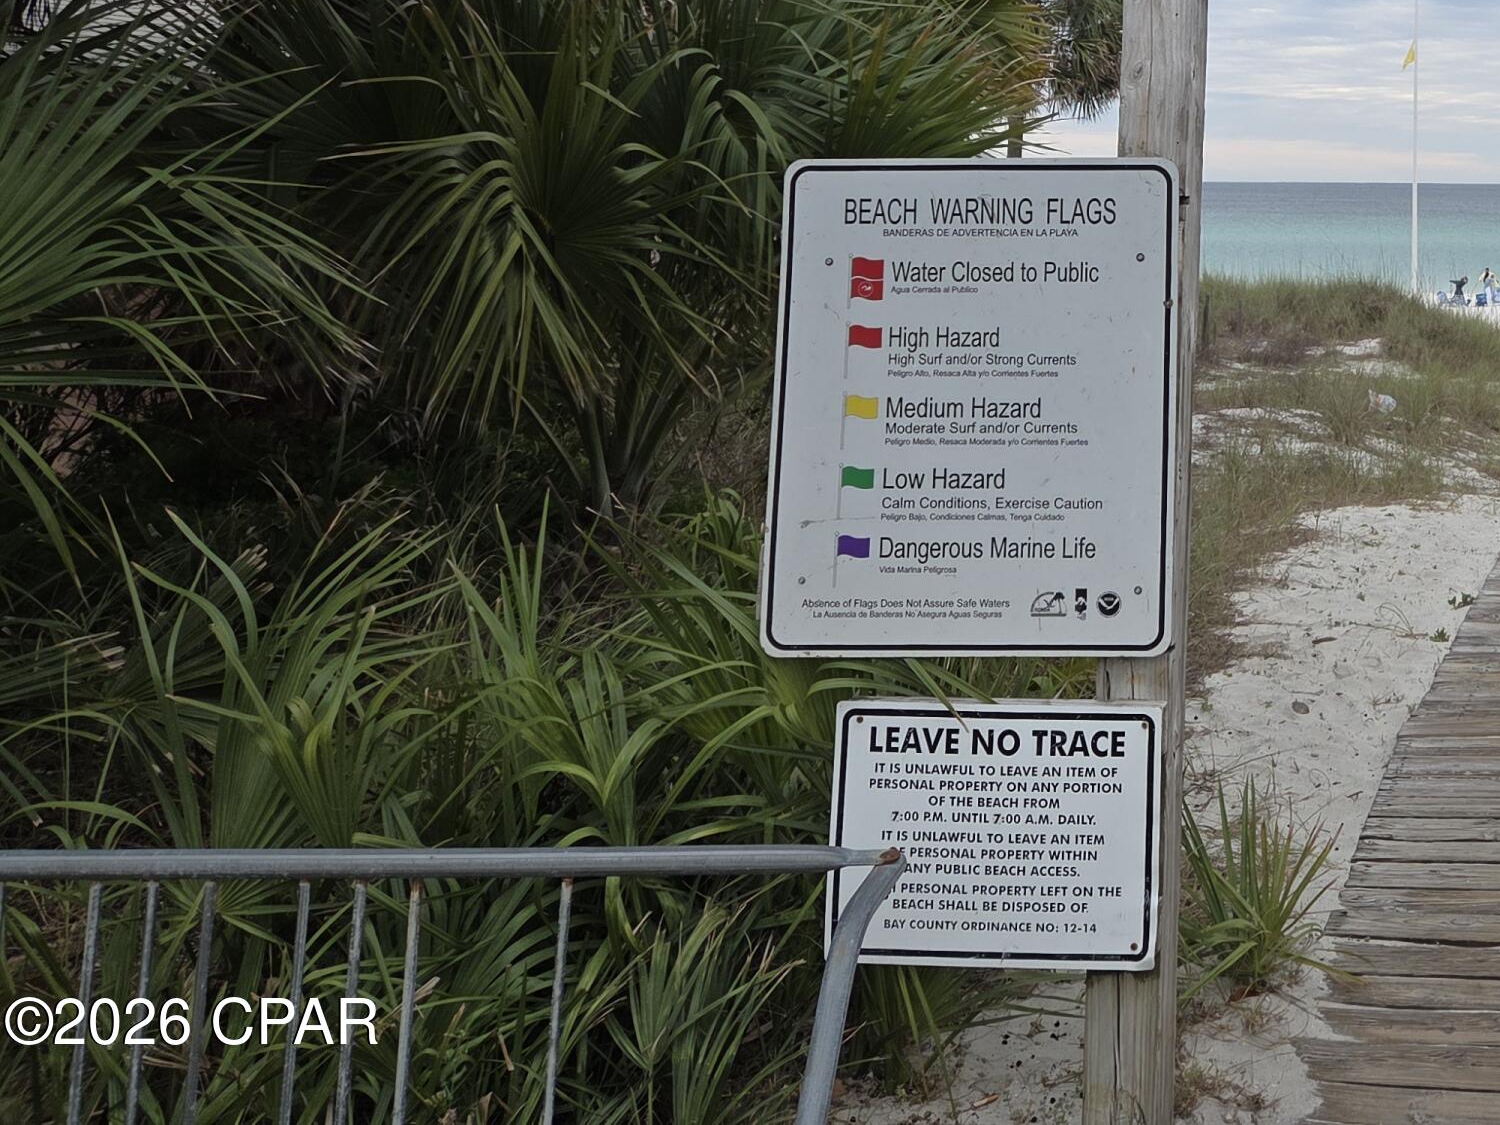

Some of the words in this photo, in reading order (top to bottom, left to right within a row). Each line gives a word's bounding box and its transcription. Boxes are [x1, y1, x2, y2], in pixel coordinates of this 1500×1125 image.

[844, 198, 917, 224] BEACH
[929, 198, 1032, 224] WARNING
[1046, 198, 1116, 224] FLAGS
[883, 228, 934, 236] BANDERAS
[936, 228, 949, 236] DE
[951, 228, 1018, 236] ADVERTENCIA
[1020, 228, 1033, 236] EN
[1035, 228, 1047, 236] LA
[1049, 228, 1078, 236] PLAYA
[891, 261, 946, 282] Water
[951, 261, 1014, 282] Closed
[1020, 263, 1037, 282] to
[1044, 261, 1099, 282] Public
[890, 286, 909, 294] Agua
[951, 285, 978, 293] Publico
[889, 326, 928, 354] High
[936, 326, 999, 347] Hazard
[888, 353, 914, 367] High
[918, 353, 942, 365] Surf
[945, 353, 982, 365] and/or
[985, 353, 1023, 367] Strong
[1027, 353, 1078, 365] Currents
[886, 397, 963, 417] Medium
[972, 397, 1041, 418] Hazard
[885, 422, 945, 434] Moderate
[949, 421, 976, 433] Surf
[979, 422, 1020, 433] and/or
[1023, 421, 1077, 433] Currents
[883, 468, 925, 489] Low
[932, 468, 1005, 489] Hazard
[882, 496, 915, 508] Calm
[919, 496, 990, 509] Conditions,
[995, 497, 1049, 509] Exercise
[1054, 497, 1102, 509] Caution
[879, 537, 982, 563] Dangerous
[990, 537, 1054, 558] Marine
[1062, 537, 1095, 558] Life
[801, 599, 840, 608] Absence
[842, 599, 852, 608] of
[853, 599, 878, 610] Flags
[880, 599, 903, 608] Does
[906, 599, 921, 608] Not
[922, 599, 954, 608] Assure
[956, 599, 976, 608] Safe
[979, 599, 1010, 608] Waters
[870, 726, 959, 754] LEAVE
[972, 729, 1019, 755] NO
[1032, 730, 1124, 757] TRACE
[874, 762, 885, 773] IT
[889, 763, 900, 773] IS
[905, 763, 974, 775] UNLAWFUL
[978, 765, 995, 775] TO
[1000, 766, 1038, 776] LEAVE
[1041, 766, 1061, 777] AN
[1066, 767, 1095, 777] ITEM
[1100, 767, 1117, 777] OF
[869, 778, 934, 789] PERSONAL
[939, 780, 1002, 791] PROPERTY
[1006, 782, 1026, 792] ON
[1031, 782, 1059, 792] ANY
[1063, 782, 1121, 793] PORTION
[928, 795, 945, 806] OF
[949, 796, 973, 807] THE
[977, 797, 1018, 807] BEACH
[1023, 798, 1059, 808] FROM
[891, 811, 918, 821] 7:00
[923, 811, 946, 822] P.M.
[952, 812, 989, 823] UNTIL
[993, 813, 1020, 824] 7:00
[1025, 814, 1052, 824] A.M.
[1058, 814, 1095, 825] DAILY.
[881, 830, 893, 840] IT
[896, 830, 908, 841] IS
[912, 831, 982, 843] UNLAWFUL
[986, 833, 1003, 843] TO
[1008, 833, 1046, 844] LEAVE
[1050, 834, 1070, 844] AN
[1075, 834, 1104, 845] ITEM
[910, 847, 976, 858] PERSONAL
[981, 849, 1044, 859] PROPERTY
[1048, 850, 1097, 860] WITHIN
[904, 863, 932, 873] ANY
[935, 863, 980, 875] PUBLIC
[984, 865, 1025, 875] BEACH
[1030, 866, 1080, 876] ACCESS.
[900, 883, 968, 894] PERSONAL
[972, 885, 1036, 895] PROPERTY
[1040, 886, 1068, 896] LEFT
[1072, 886, 1093, 896] ON
[1097, 886, 1121, 896] THE
[892, 898, 933, 909] BEACH
[938, 899, 977, 910] SHALL
[982, 901, 997, 911] BE
[1002, 901, 1065, 912] DISPOSED
[884, 919, 906, 929] BAY
[909, 919, 957, 929] COUNTY
[961, 921, 1031, 931] ORDINANCE
[1036, 923, 1058, 932] NO:
[1064, 923, 1096, 933] 12-14
